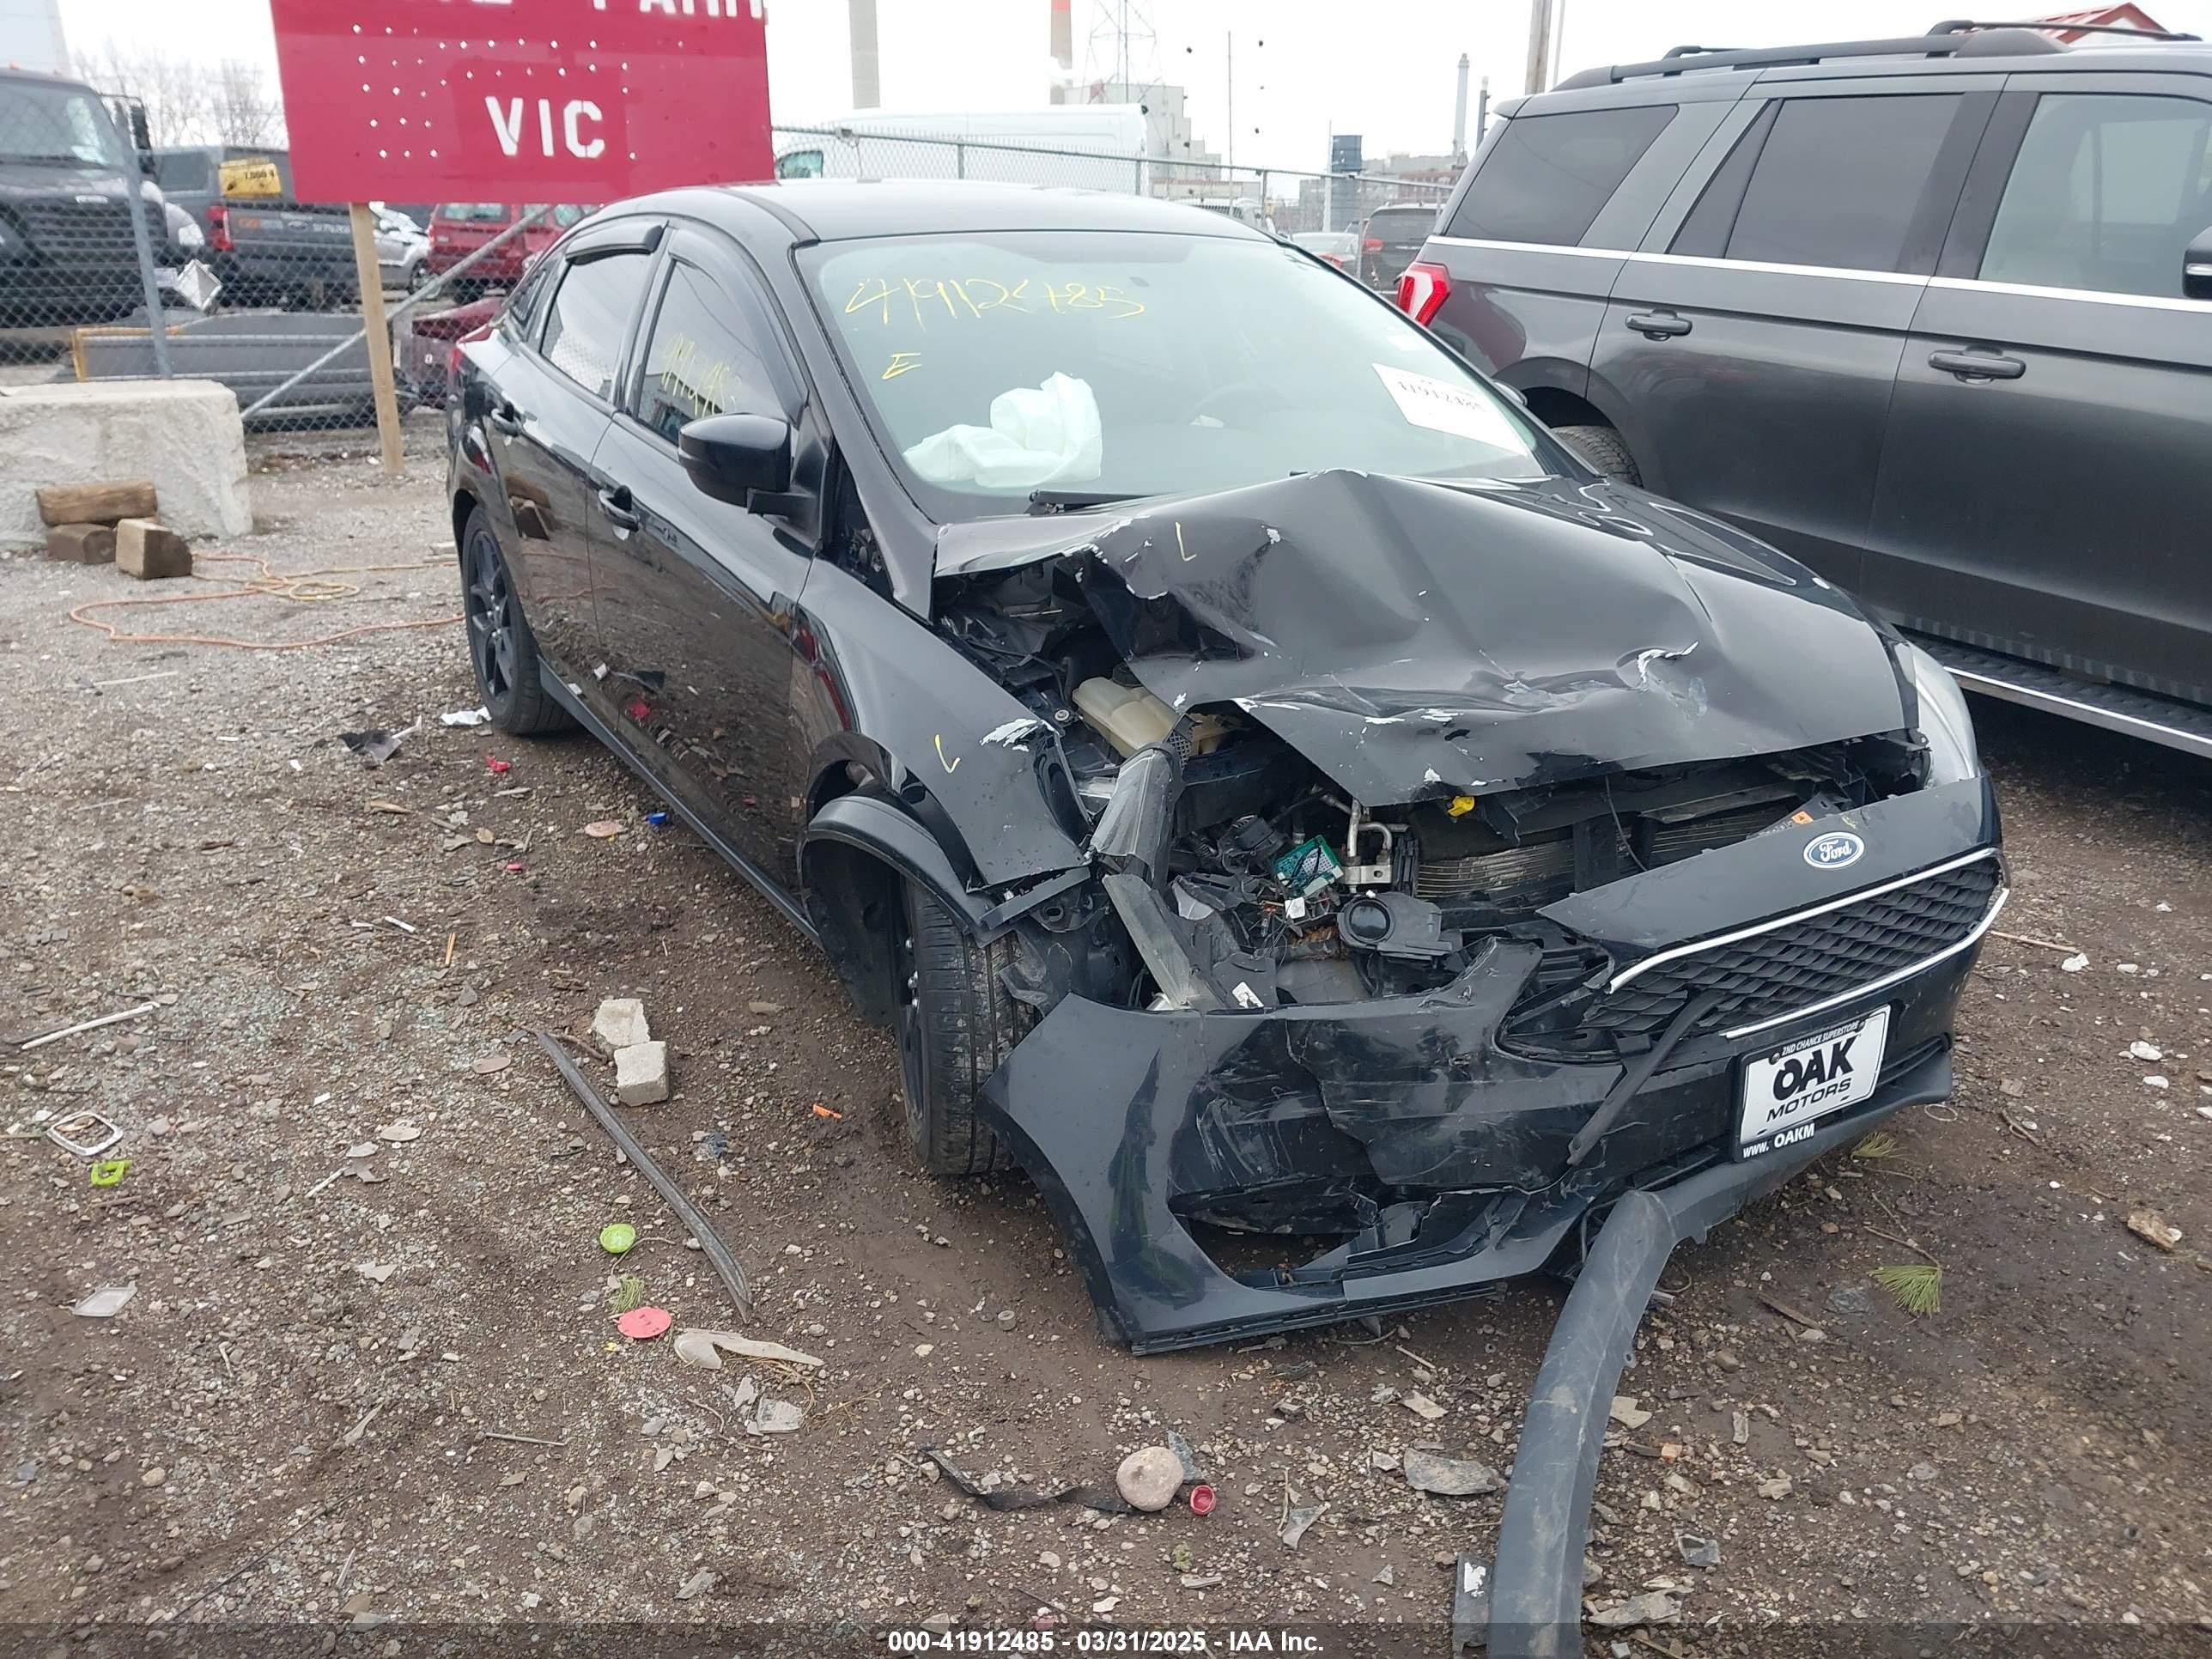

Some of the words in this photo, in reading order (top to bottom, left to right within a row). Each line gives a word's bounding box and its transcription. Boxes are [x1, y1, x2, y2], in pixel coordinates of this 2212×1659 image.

[484, 95, 606, 159] VIC
[882, 352, 922, 380] E
[1819, 839, 1853, 862] Ford
[1782, 1043, 1796, 1056] 2ND
[1796, 1034, 1822, 1050] CHANCE
[1822, 1020, 1860, 1042] SUPERSTORE
[1772, 1035, 1859, 1101] OAK
[1765, 1077, 1852, 1122] MOTORS
[1774, 1122, 1815, 1148] OAKM
